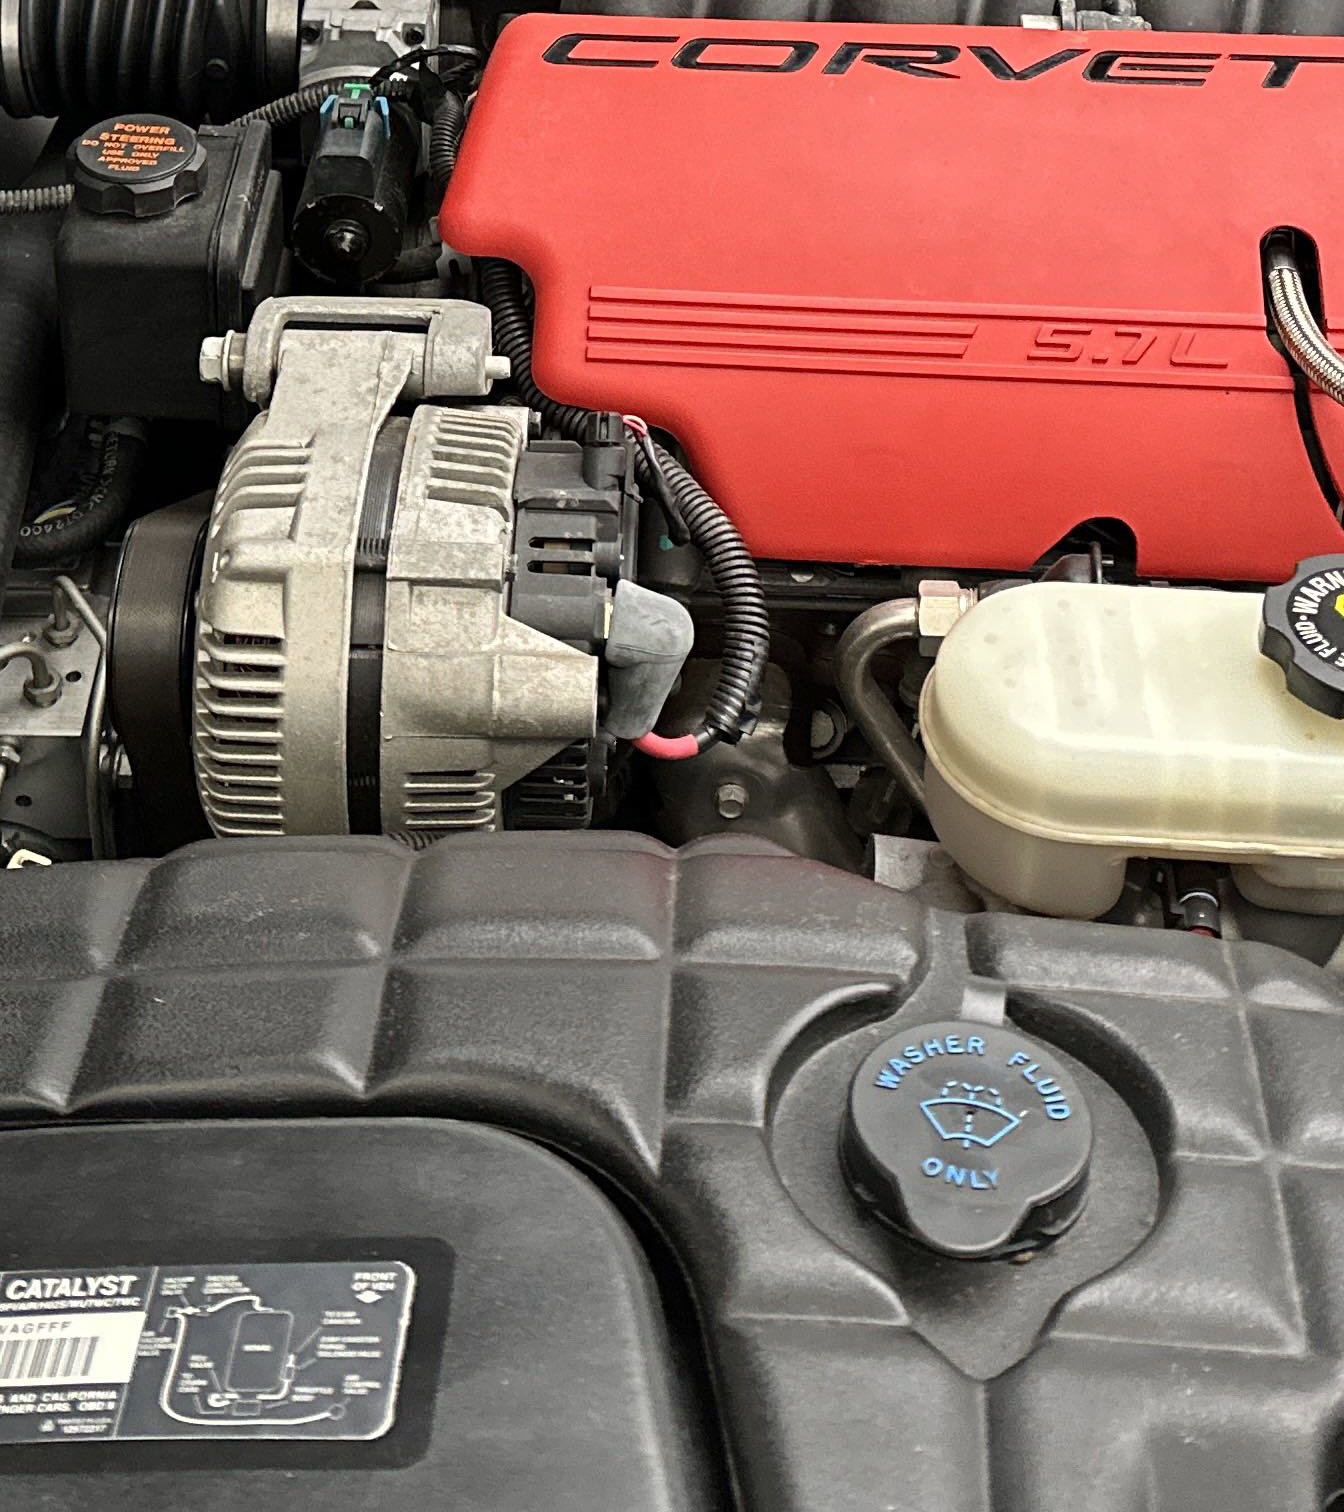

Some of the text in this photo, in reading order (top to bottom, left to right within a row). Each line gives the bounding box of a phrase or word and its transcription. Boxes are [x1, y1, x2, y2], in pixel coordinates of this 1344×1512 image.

[114, 122, 171, 135] POWER
[81, 139, 185, 153] DO NOT OVERFILL
[99, 132, 176, 146] STEERING
[97, 156, 158, 166] APPROVED
[102, 149, 160, 159] USE ONLY
[108, 164, 141, 172] FLUID
[1025, 323, 1230, 370] 5.7L
[1294, 622, 1338, 658] FLUID
[874, 1035, 1072, 1121] WASHER FLUID
[920, 1156, 1001, 1190] ONLY
[353, 1272, 398, 1281] FRONT
[6, 1275, 138, 1300] CATALYST
[9, 1393, 38, 1403] AND
[42, 1390, 117, 1402] CALIFORNIA
